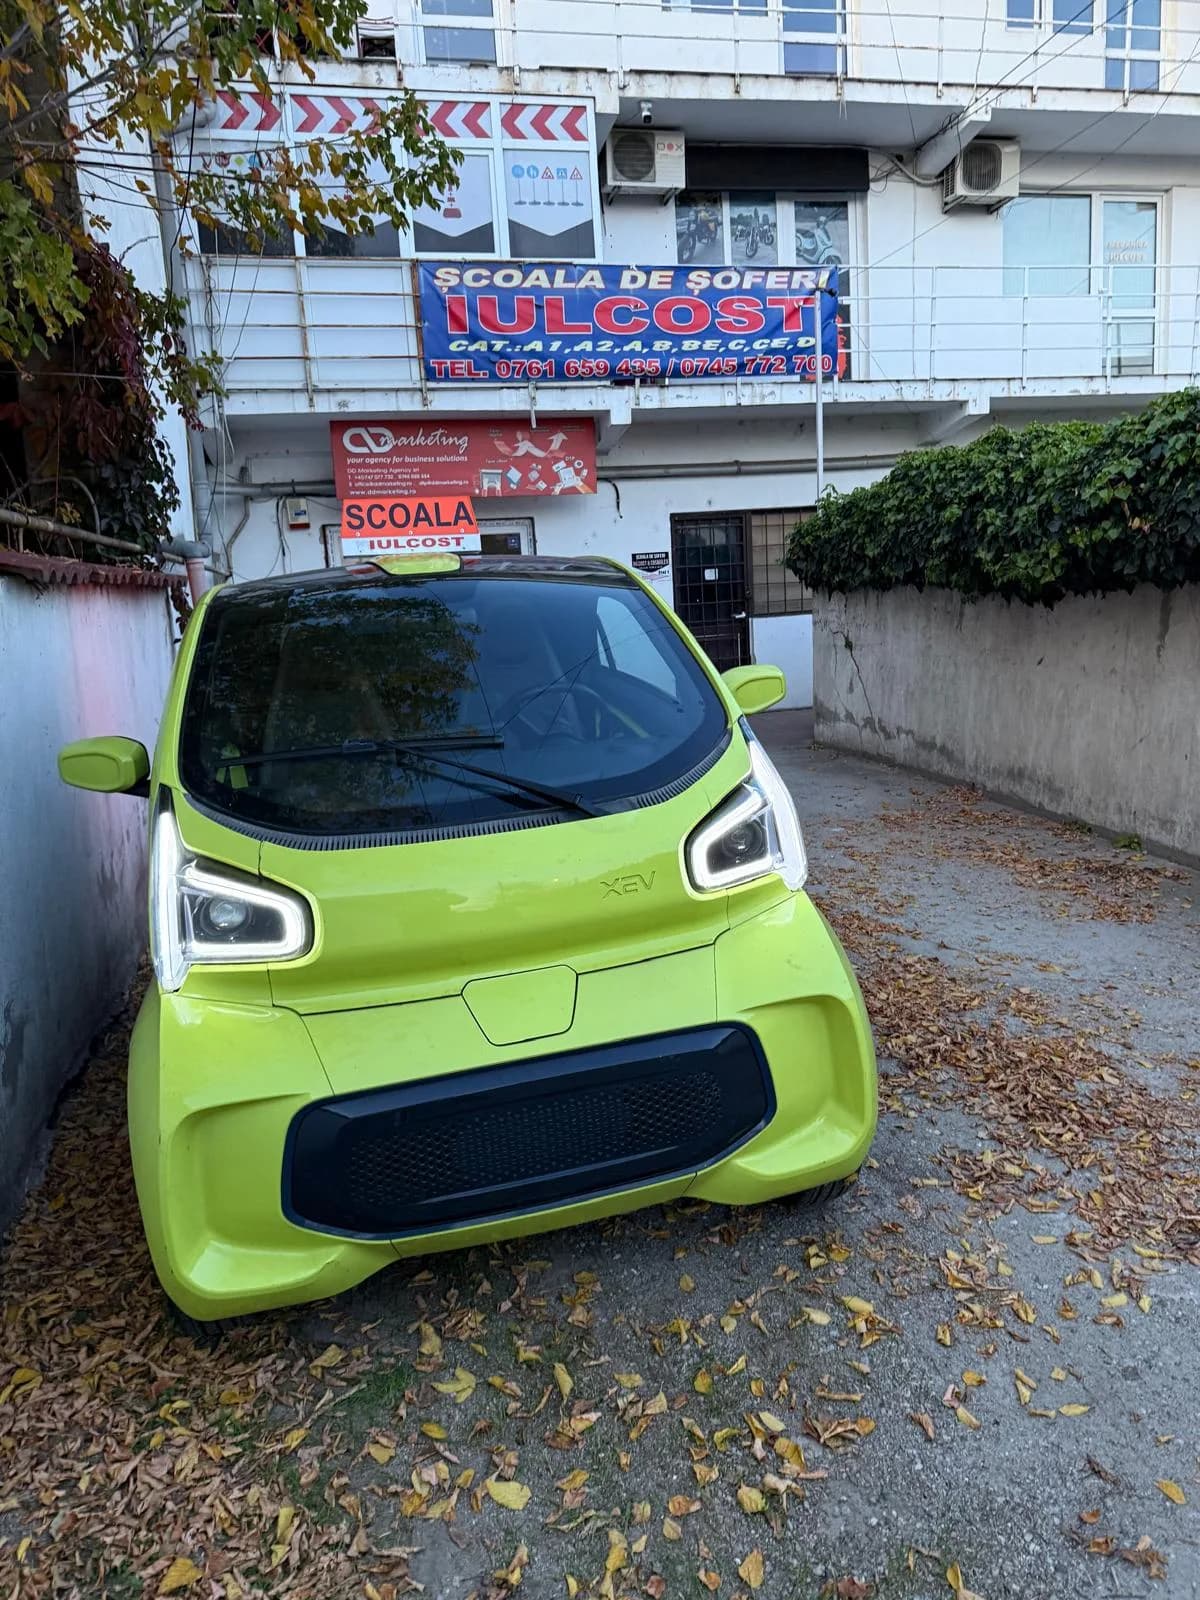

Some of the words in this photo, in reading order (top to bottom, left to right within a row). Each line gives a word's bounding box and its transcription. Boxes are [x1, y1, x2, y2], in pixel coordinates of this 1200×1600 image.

[619, 270, 674, 289] DE
[446, 295, 816, 335] IULCOST
[431, 359, 489, 379] TEL.
[496, 358, 555, 379] 0761
[564, 358, 610, 378] 659
[616, 357, 660, 377] 435
[666, 358, 675, 376] /
[680, 357, 738, 376] 0745
[744, 355, 786, 374] 772
[792, 354, 833, 374] 700
[346, 457, 366, 465] your
[366, 456, 392, 465] agency
[392, 455, 404, 464] for
[404, 455, 435, 463] business
[436, 454, 468, 462] solutions
[345, 501, 474, 530] SCOALA
[368, 537, 465, 550] IULCOST
